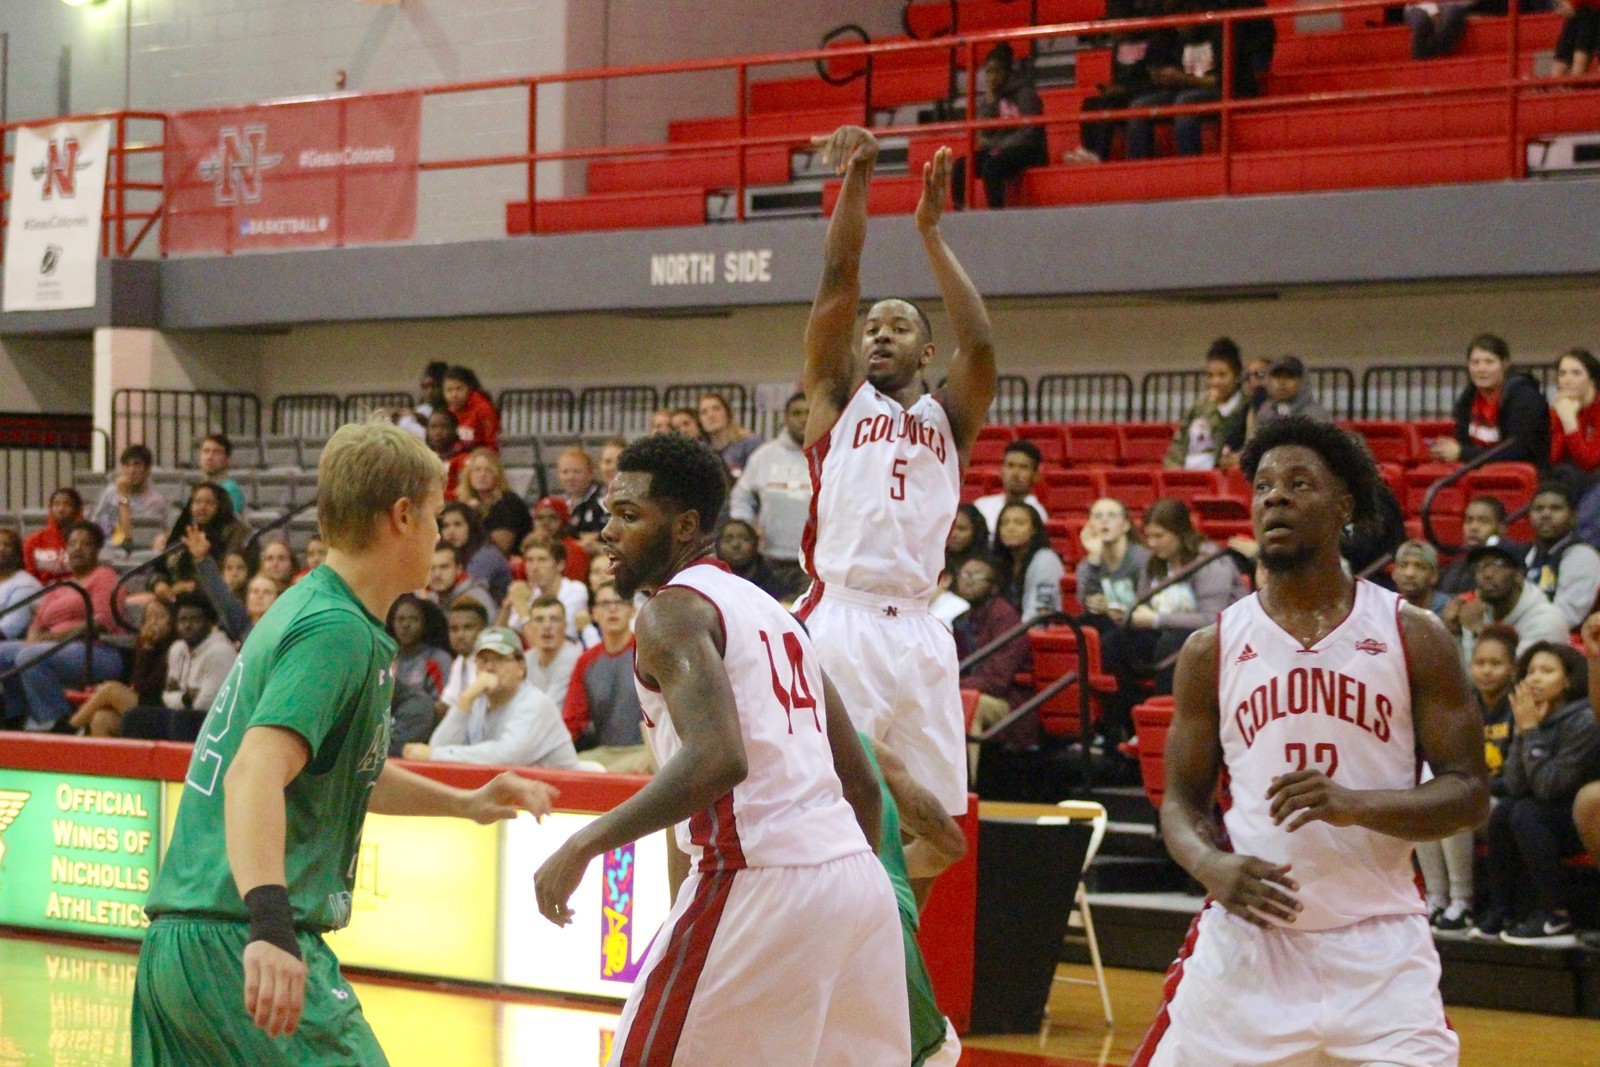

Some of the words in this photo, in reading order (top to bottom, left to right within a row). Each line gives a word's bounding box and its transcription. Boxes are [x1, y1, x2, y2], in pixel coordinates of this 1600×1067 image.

[650, 252, 716, 287] NORTH
[723, 248, 773, 283] SIDE
[889, 458, 908, 502] 5
[758, 629, 823, 735] 14
[1234, 667, 1393, 749] COLONELS
[56, 782, 148, 818] OFFICIAL
[52, 818, 119, 853] WINGS
[123, 829, 151, 855] OF
[50, 854, 150, 892] NICHOLLS
